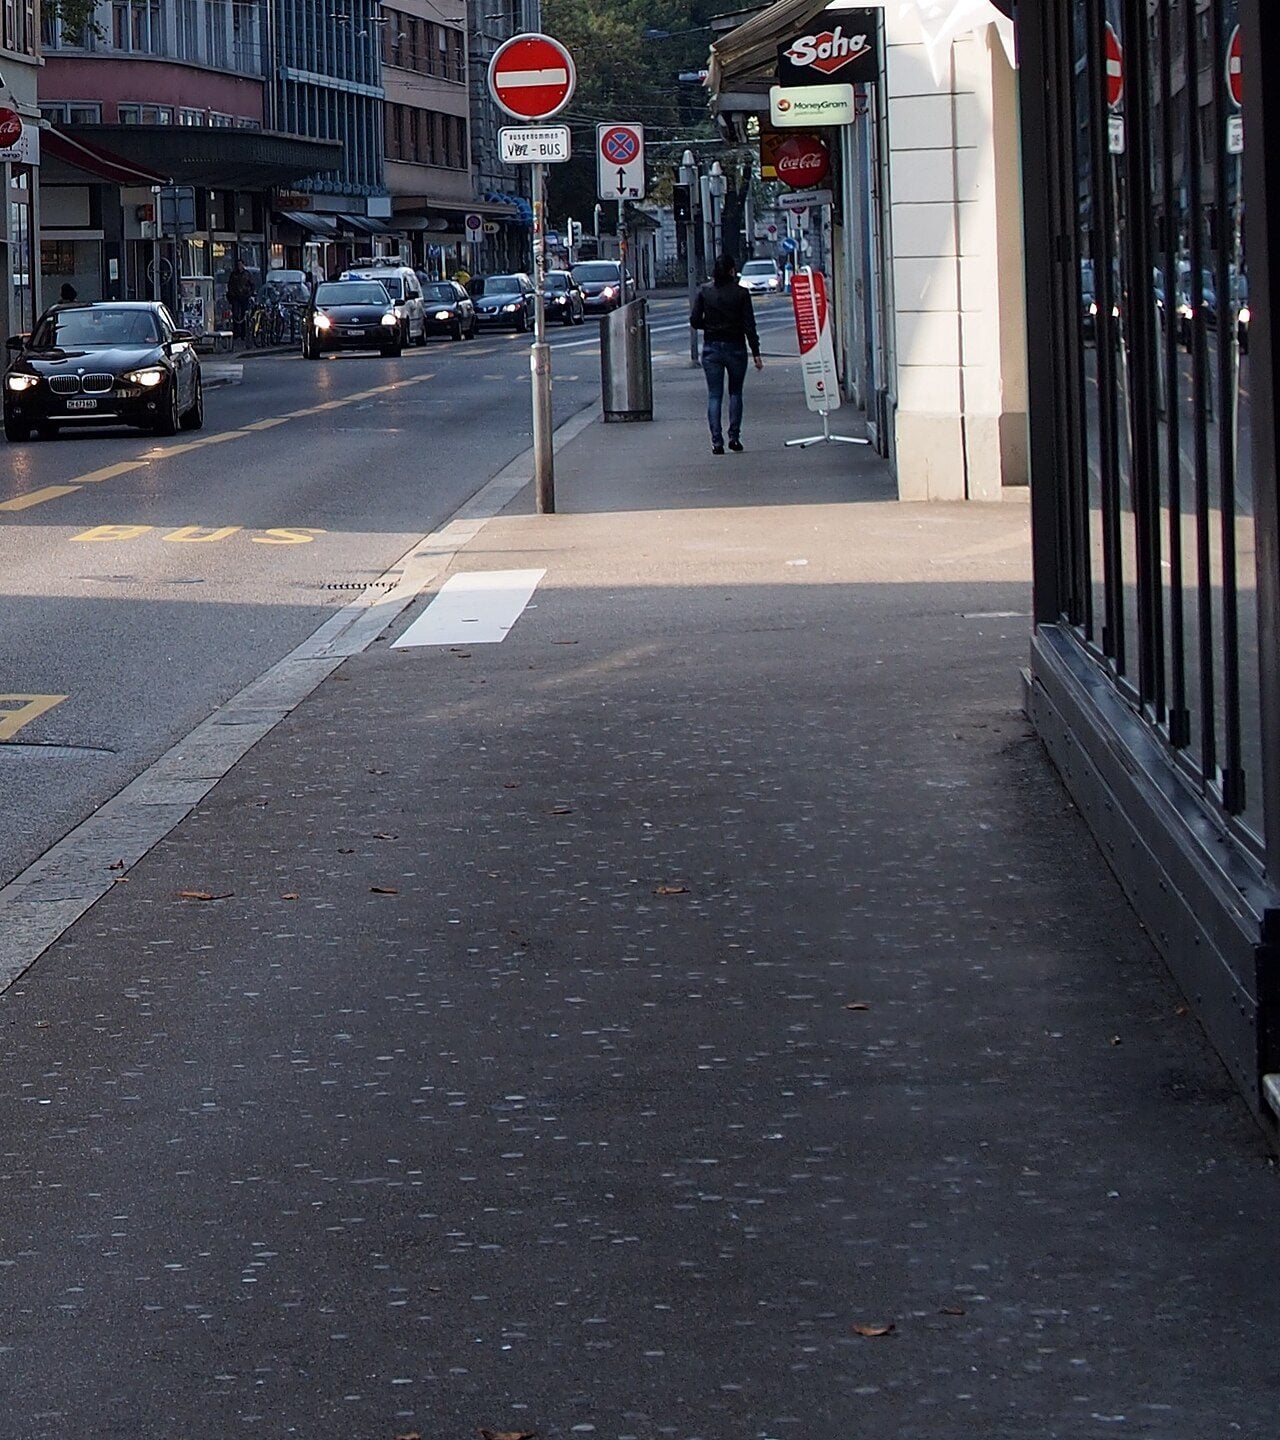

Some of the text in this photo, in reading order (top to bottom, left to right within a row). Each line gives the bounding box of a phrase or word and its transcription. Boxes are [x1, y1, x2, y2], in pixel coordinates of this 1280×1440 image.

[790, 26, 867, 66] Soho
[794, 101, 848, 111] MoneyGram
[540, 143, 561, 155] BUS
[69, 524, 328, 545] BUS
